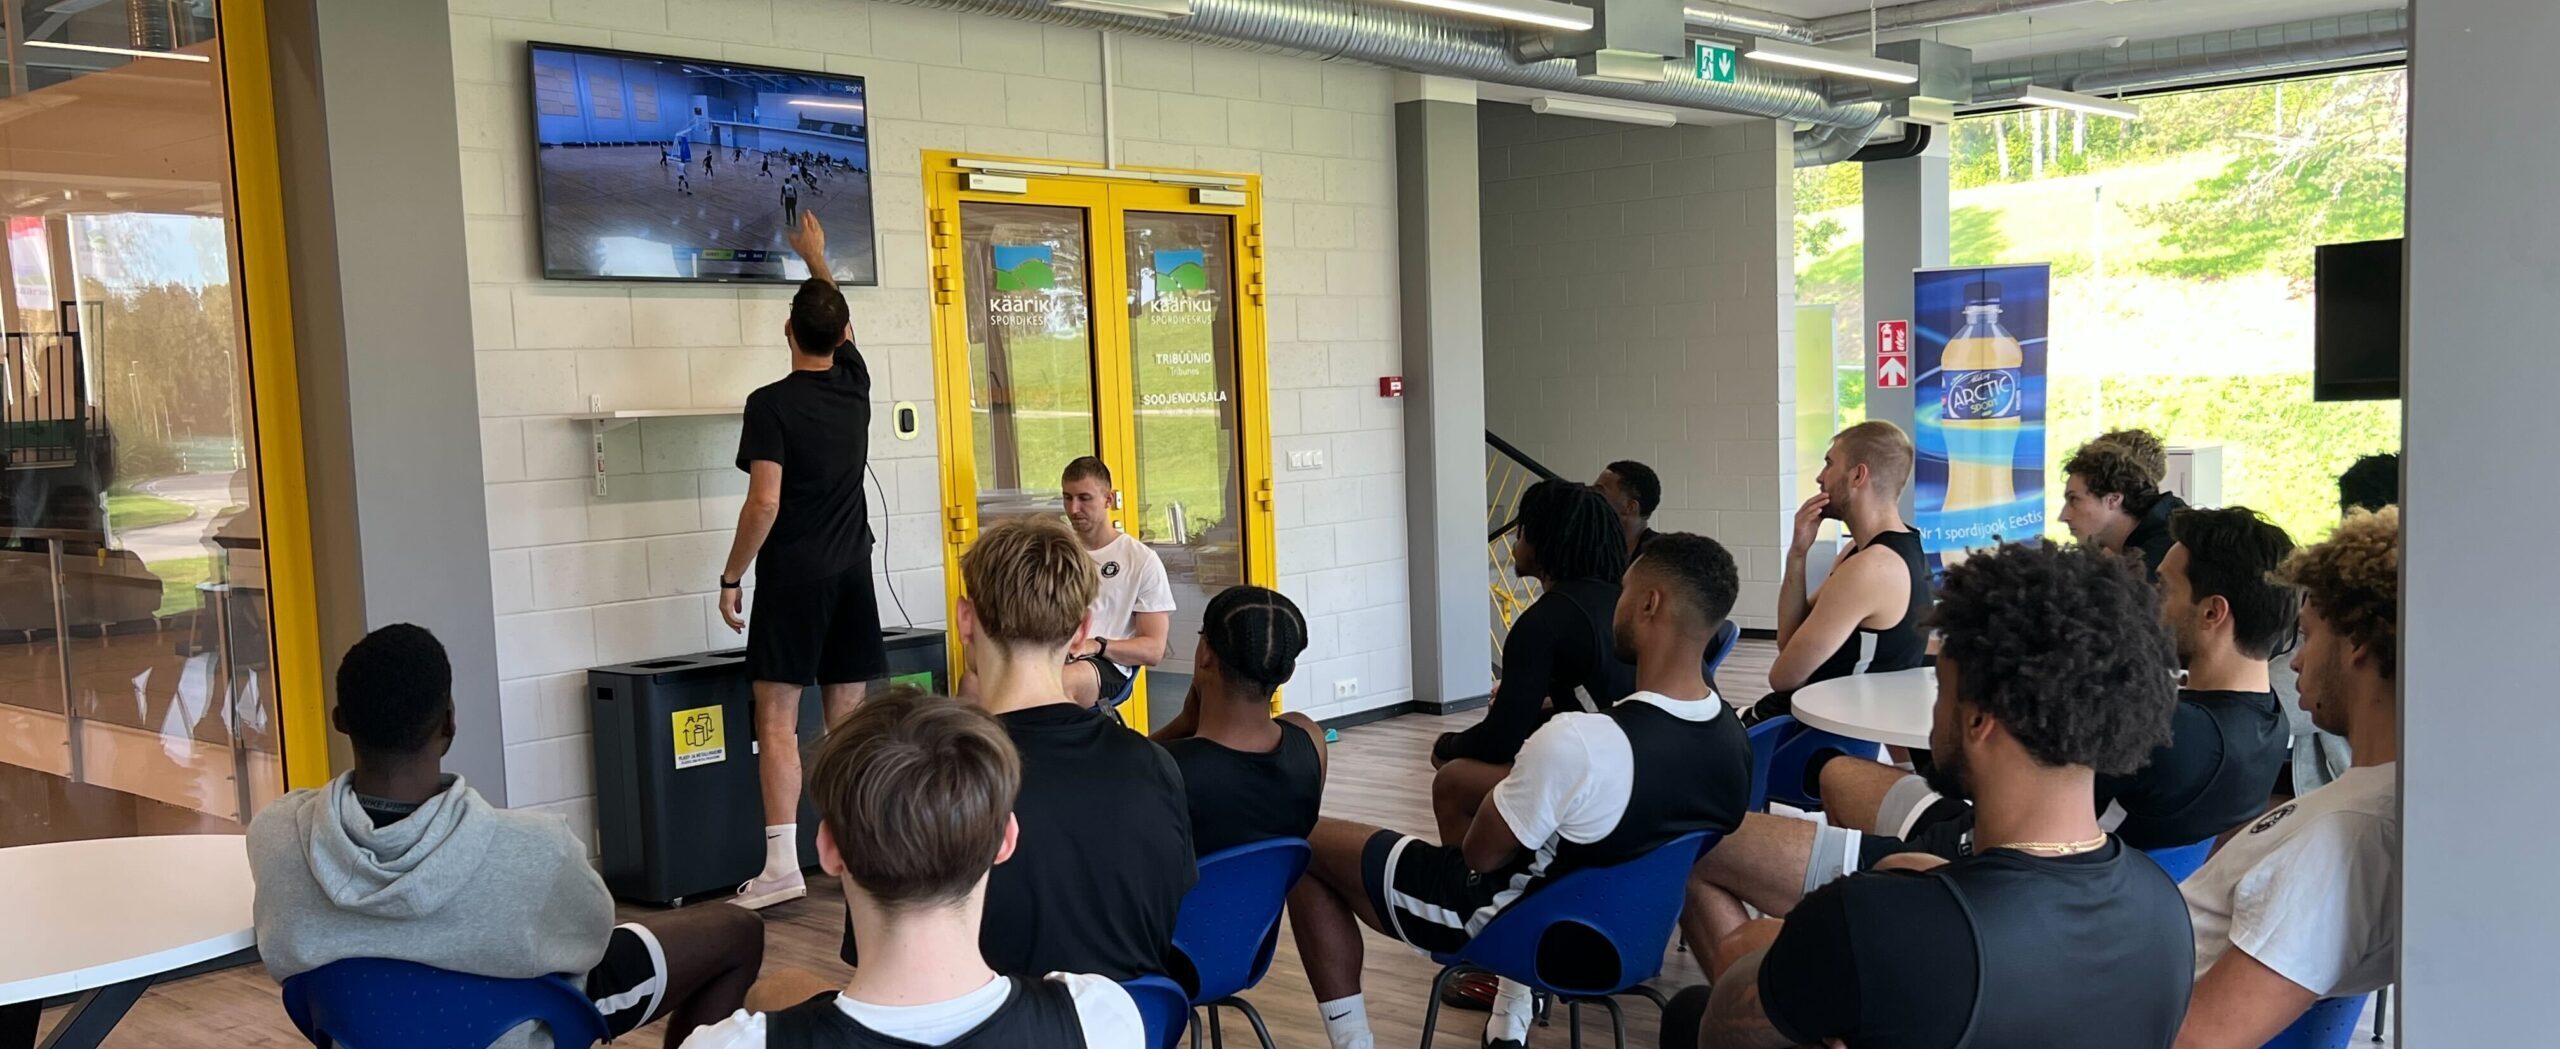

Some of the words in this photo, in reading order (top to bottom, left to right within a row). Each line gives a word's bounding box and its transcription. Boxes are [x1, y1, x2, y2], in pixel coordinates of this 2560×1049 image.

[1151, 314, 1212, 326] SPORDIKESKUS
[1155, 350, 1212, 365] TRIBÜÜNID
[1143, 390, 1227, 406] SOOJENDUSALA
[1953, 375, 2011, 409] ARCTIC
[1970, 398, 1999, 414] SPORT
[1918, 527, 1932, 539] Nr
[1935, 527, 1942, 540] 1
[1945, 518, 2008, 542] spordijook
[2009, 511, 2043, 529] Eestis
[360, 797, 385, 809] NIKE
